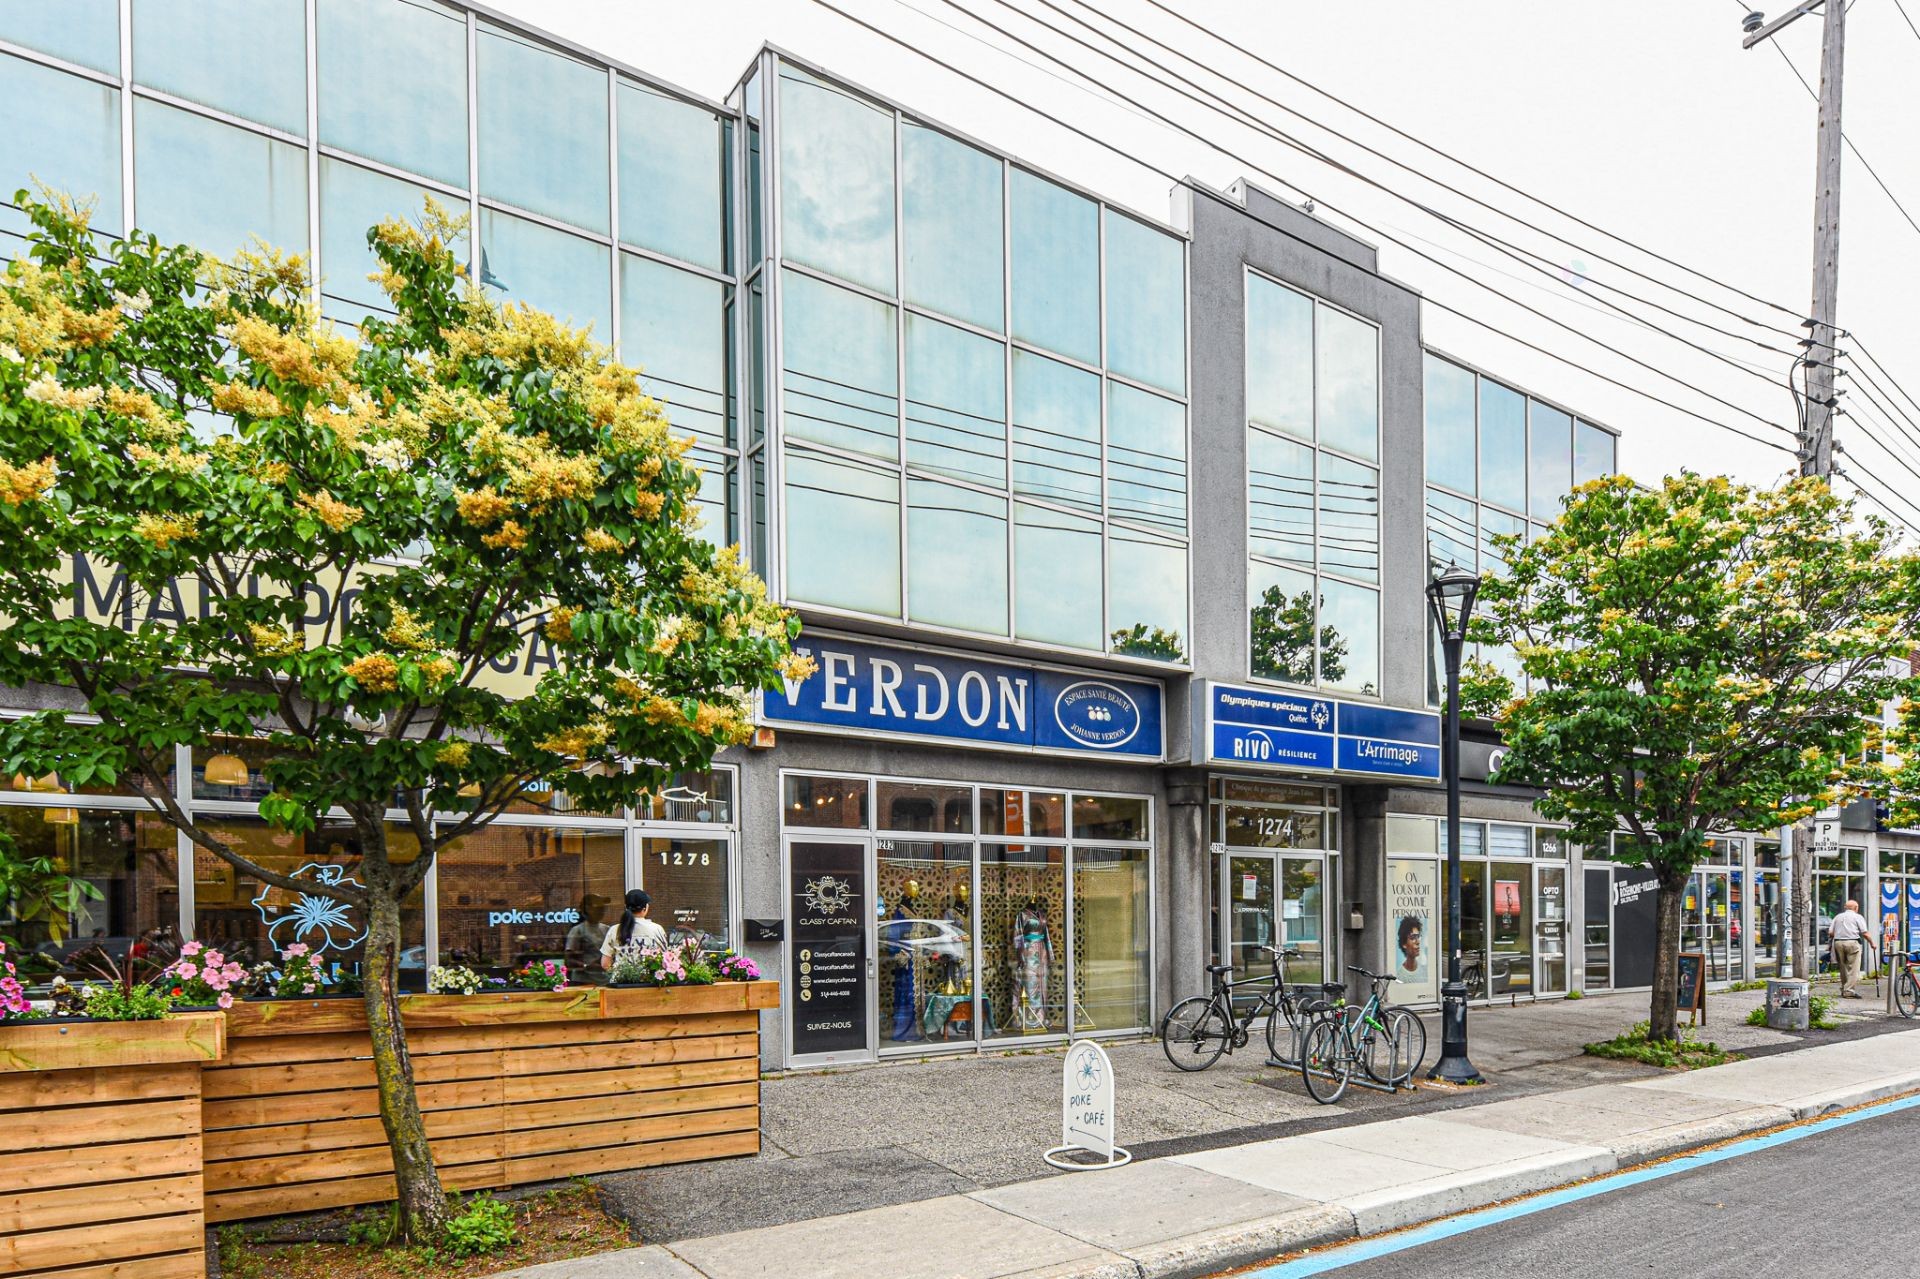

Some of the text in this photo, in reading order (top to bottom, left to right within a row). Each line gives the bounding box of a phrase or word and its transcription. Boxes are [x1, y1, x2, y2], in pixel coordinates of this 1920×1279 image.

[779, 647, 1028, 732] VERDON
[1064, 688, 1131, 712] ESPACE SANTÉ BEAUTÉ
[1220, 693, 1308, 713] Olympiques spéciaux
[1070, 723, 1126, 741] JOHANNE VERDON
[1233, 737, 1317, 760] RIVO RÉSILIENCE
[1357, 739, 1419, 766] L'Arrimage
[1257, 817, 1292, 837] 1274
[1823, 824, 1831, 835] P
[1542, 842, 1557, 853] 1266
[660, 852, 710, 866] 1278
[1543, 886, 1560, 895] OPTO
[799, 918, 826, 926] CLASSY
[806, 1021, 852, 1031] SUIVEZ-NOUS
[1070, 1094, 1092, 1108] POKE
[1083, 1110, 1105, 1126] CAFÉ
